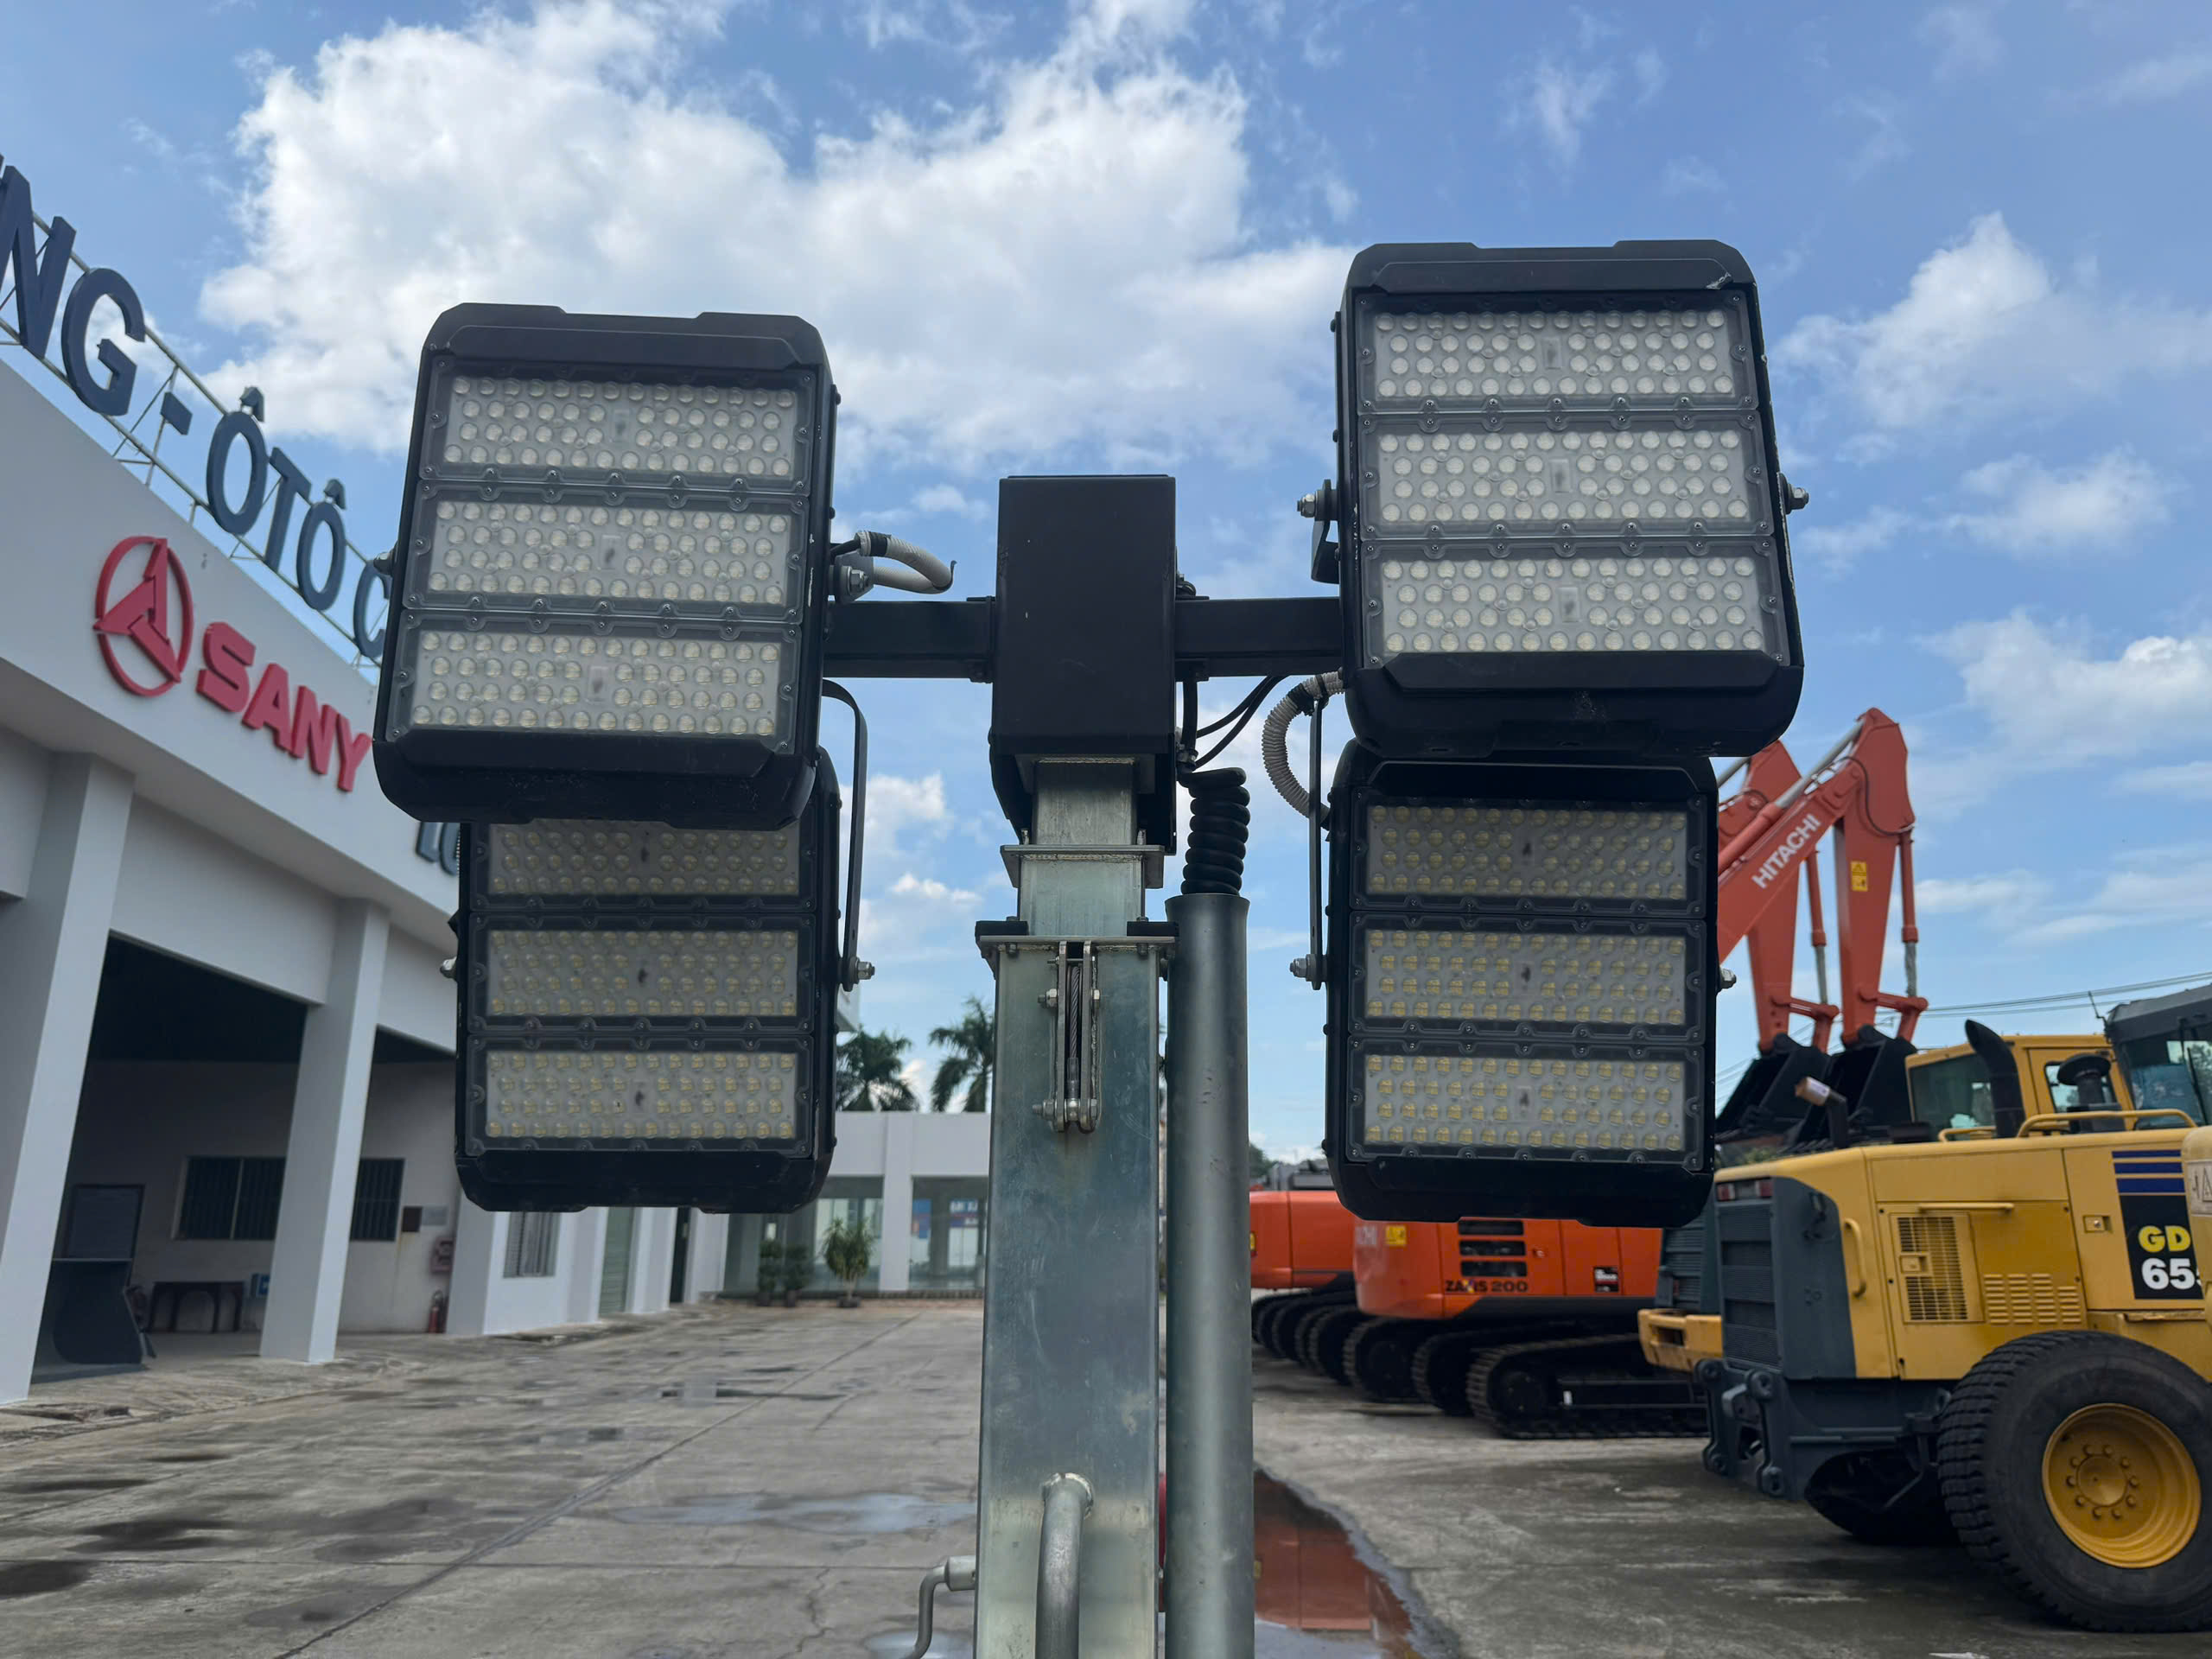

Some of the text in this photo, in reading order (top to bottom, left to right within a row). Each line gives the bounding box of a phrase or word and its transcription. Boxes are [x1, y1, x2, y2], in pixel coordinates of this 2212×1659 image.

[195, 621, 373, 792] SANY
[1751, 814, 1821, 889] HITACHI
[2139, 1225, 2191, 1253] GD
[1491, 1281, 1529, 1294] 200
[2141, 1258, 2202, 1290] 65
